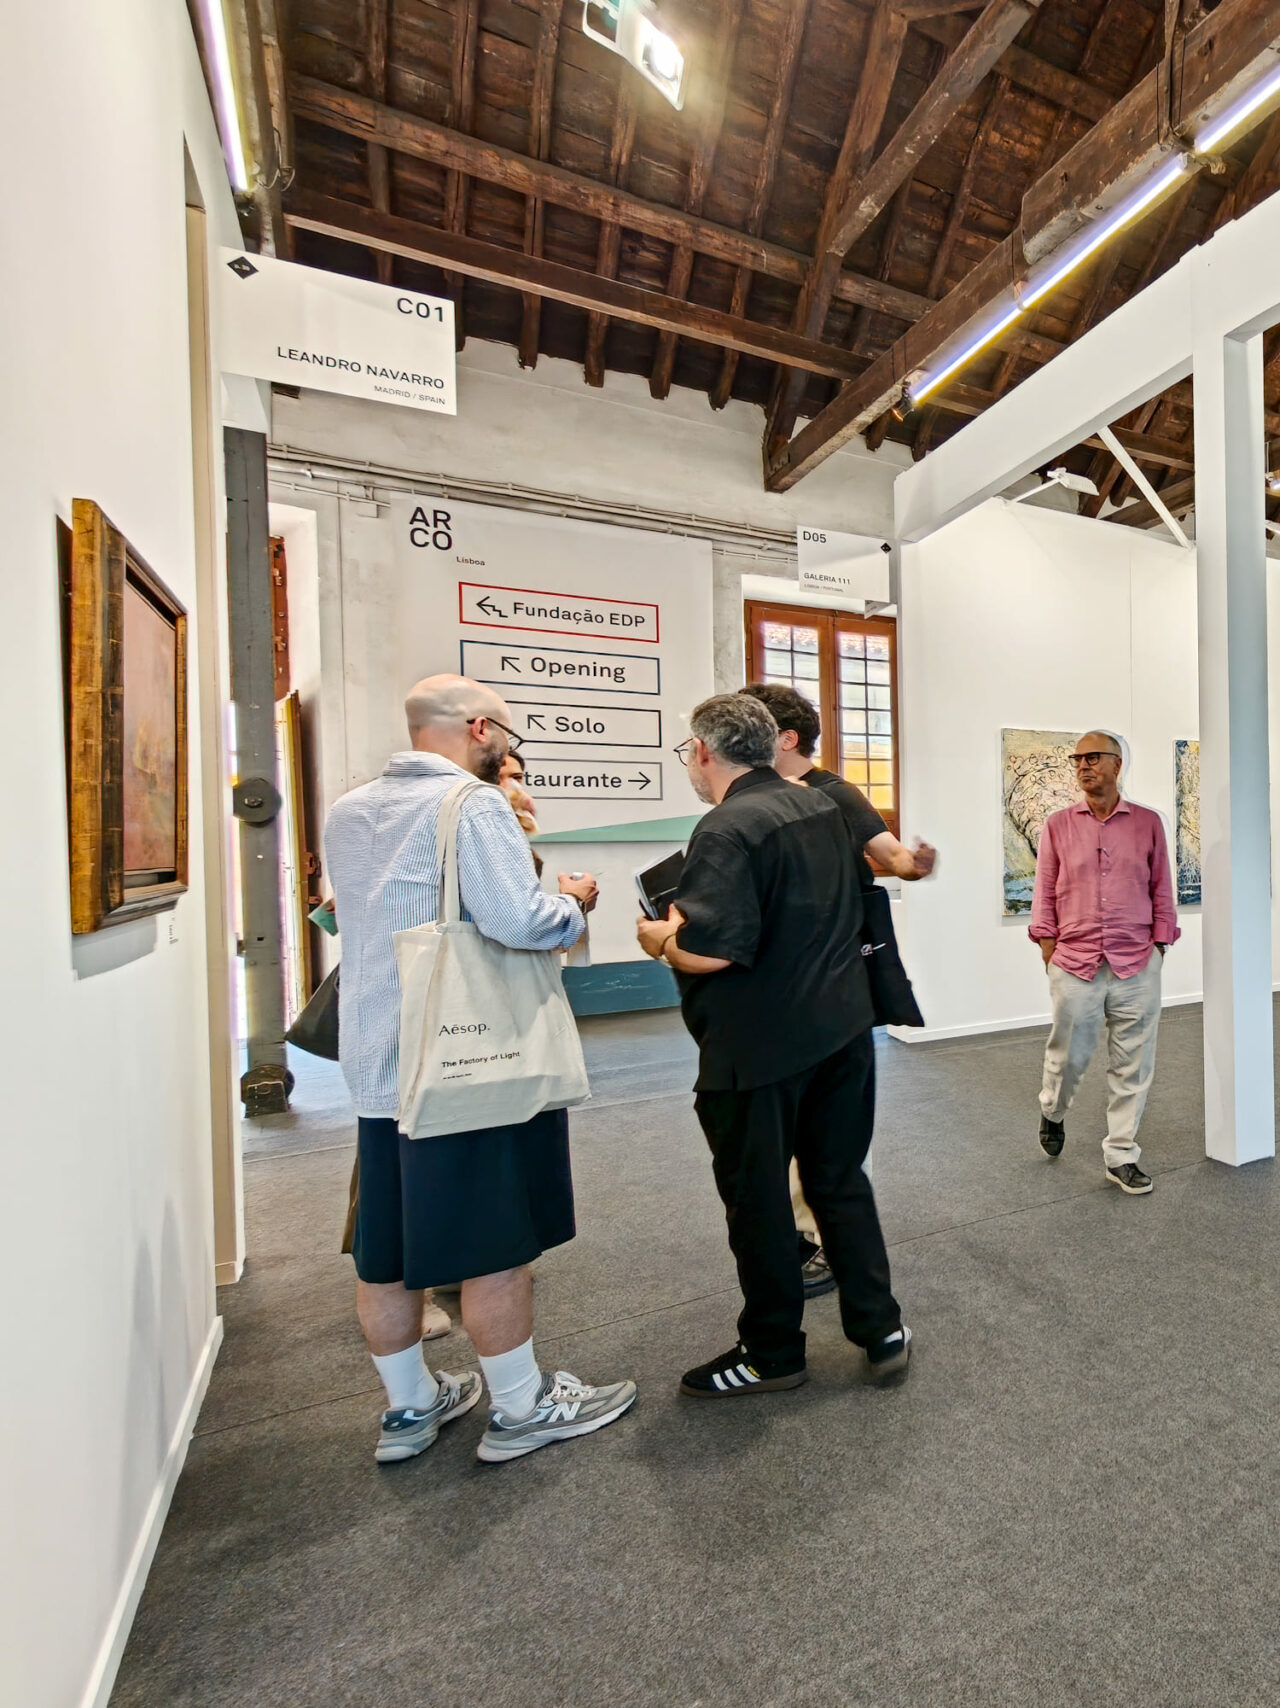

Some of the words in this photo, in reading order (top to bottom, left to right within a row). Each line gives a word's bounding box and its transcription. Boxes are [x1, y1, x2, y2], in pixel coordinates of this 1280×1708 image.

[396, 297, 445, 323] C01
[277, 346, 362, 373] LEANDRO
[366, 364, 445, 390] NAVARRO
[373, 384, 411, 399] MADRID
[418, 393, 446, 405] SPAIN
[408, 506, 452, 530] AR
[409, 528, 453, 551] CO
[802, 530, 827, 544] D05
[455, 555, 486, 566] Lisboa
[803, 572, 837, 584] GALERIA
[838, 577, 851, 585] 111
[512, 602, 605, 625] Fundação
[609, 612, 646, 628] EDP
[530, 656, 627, 684] Opening
[554, 715, 606, 734] Solo
[524, 771, 622, 789] taurante
[458, 1055, 488, 1066] Factory
[499, 1051, 521, 1061] Light
